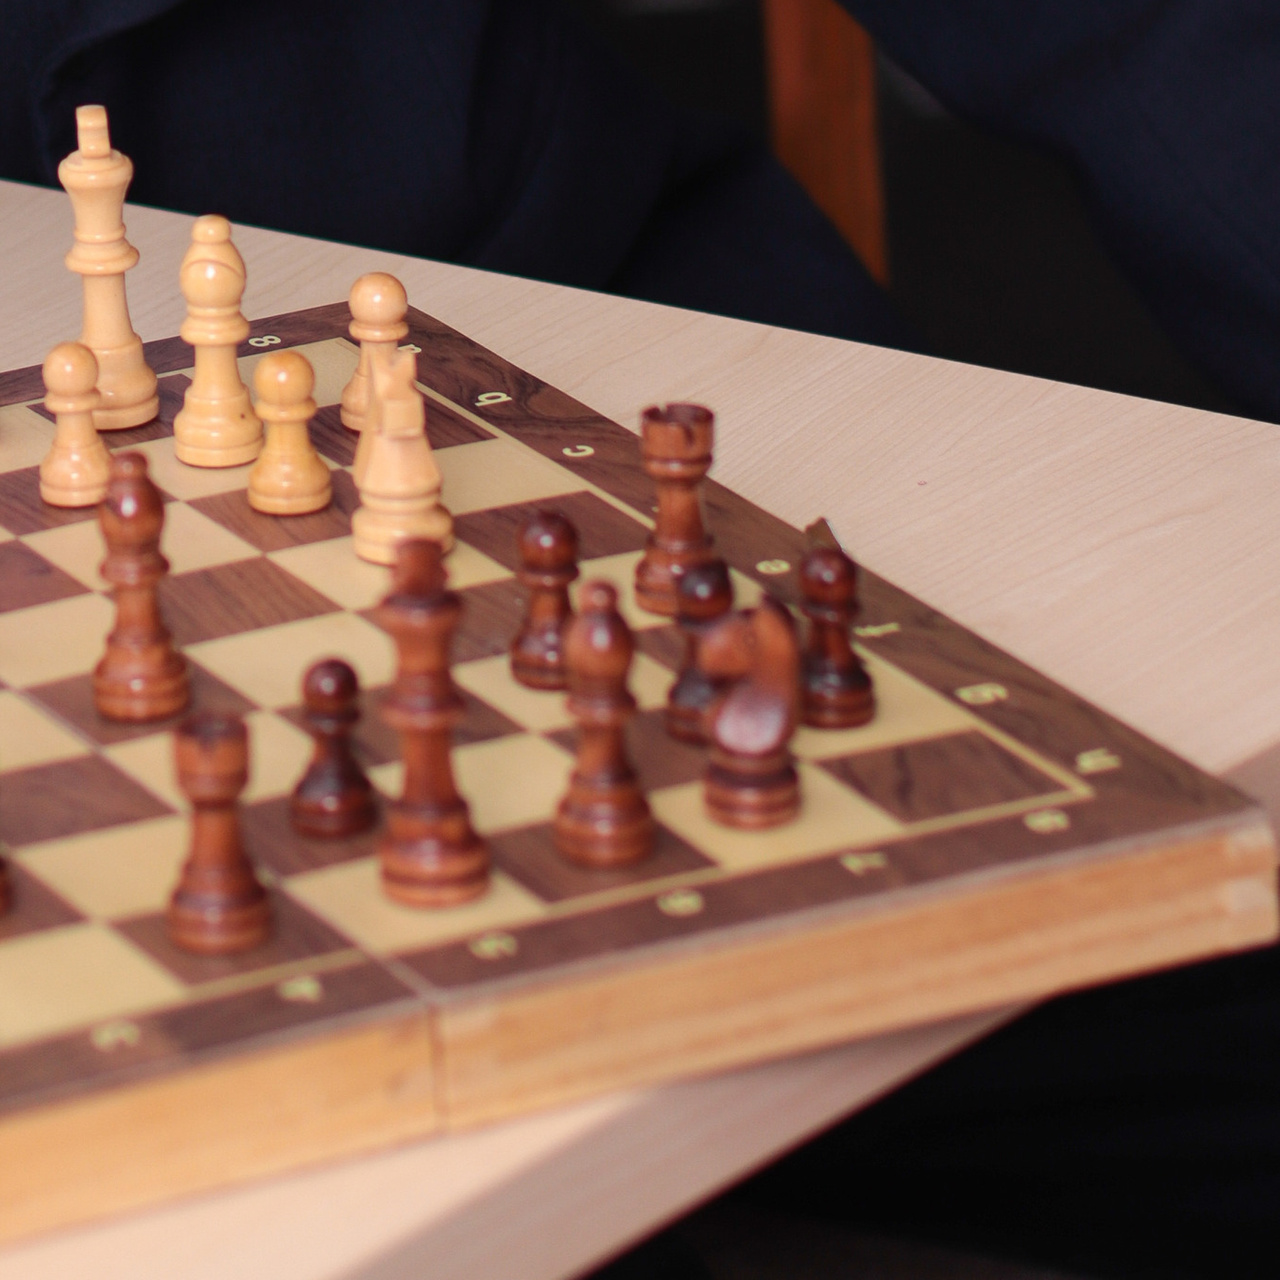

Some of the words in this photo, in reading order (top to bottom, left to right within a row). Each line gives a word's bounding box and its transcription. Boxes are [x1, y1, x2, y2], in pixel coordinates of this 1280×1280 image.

[248, 334, 282, 348] 8
[475, 391, 513, 407] b
[561, 444, 595, 458] c
